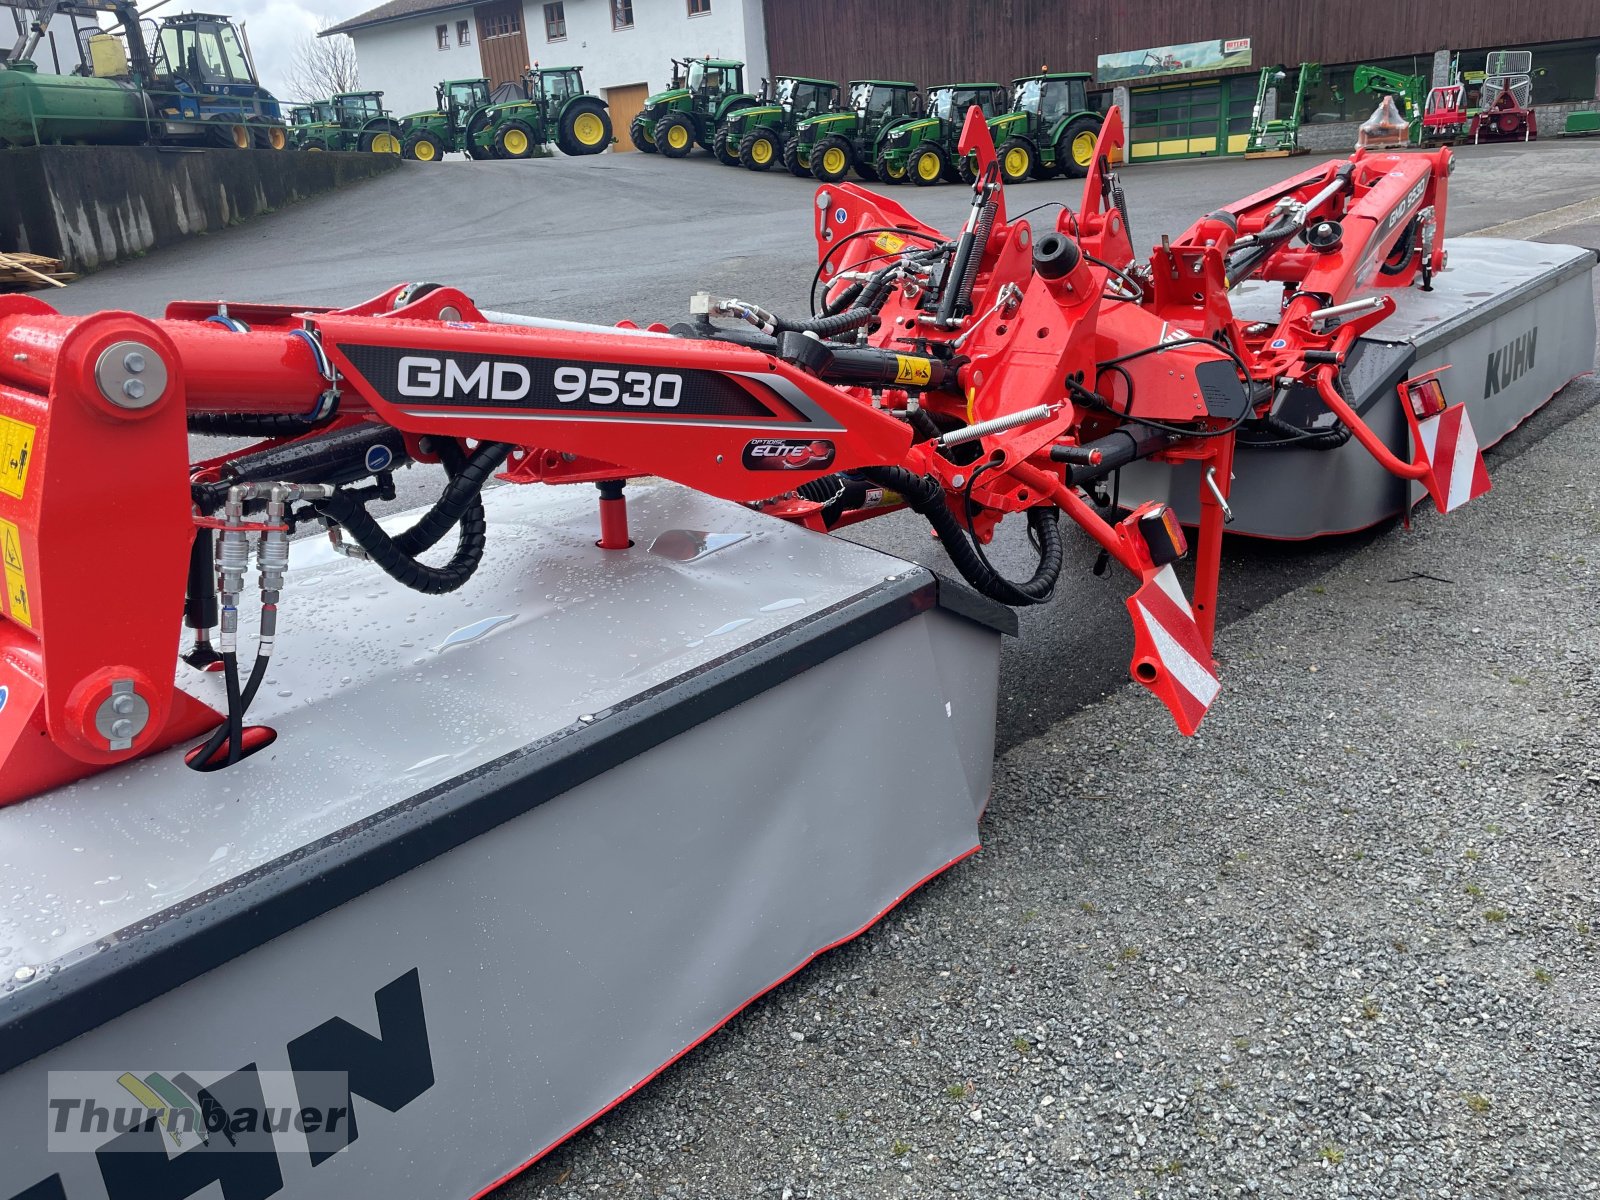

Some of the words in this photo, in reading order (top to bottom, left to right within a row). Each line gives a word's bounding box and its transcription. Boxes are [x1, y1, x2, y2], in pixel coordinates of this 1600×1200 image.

[1389, 200, 1406, 228] GMD
[1407, 178, 1425, 208] 9530
[397, 356, 531, 400] GMD
[553, 366, 683, 407] 9530
[1484, 326, 1538, 399] KUHN
[751, 445, 806, 457] ELITE
